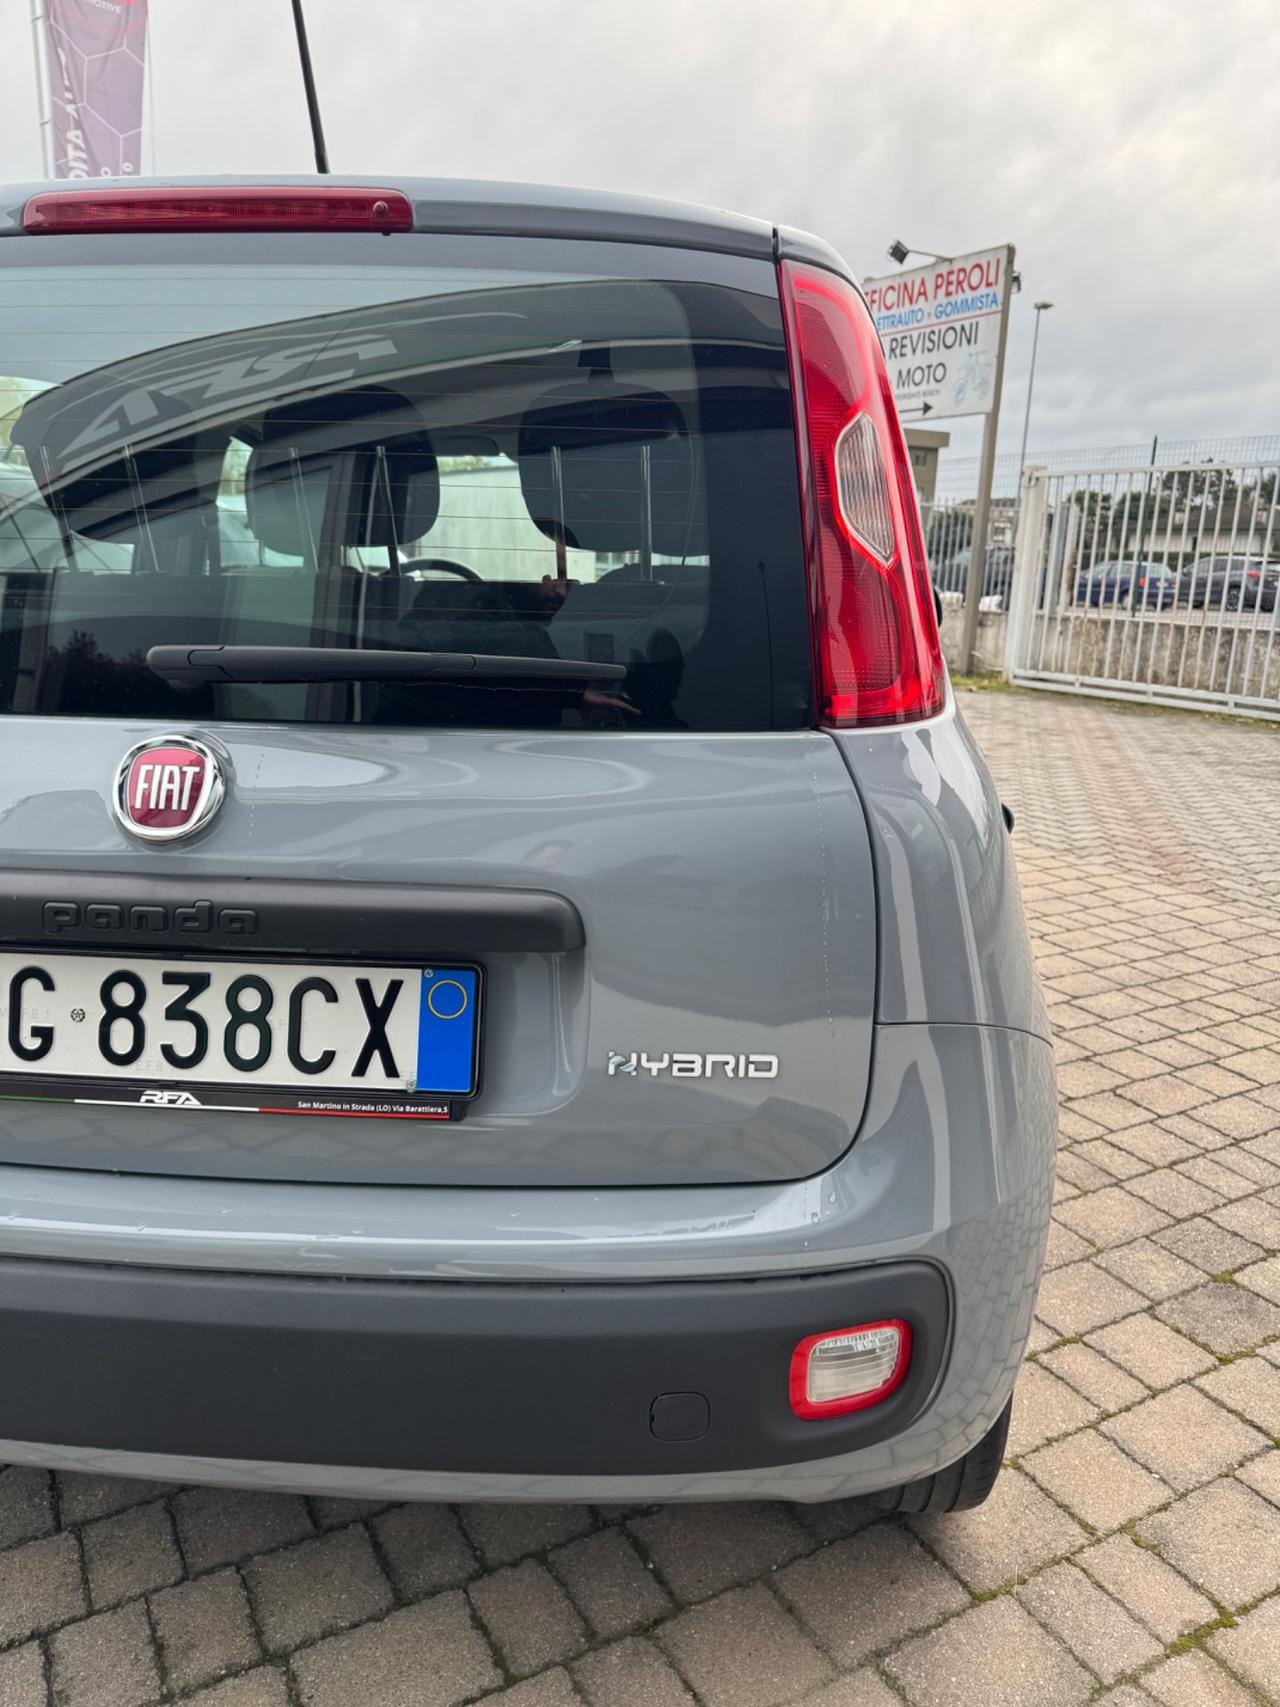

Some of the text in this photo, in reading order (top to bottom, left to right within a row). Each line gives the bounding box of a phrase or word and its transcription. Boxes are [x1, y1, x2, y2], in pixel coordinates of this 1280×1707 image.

[865, 258, 1000, 313] FICINA PEROLI
[934, 292, 999, 319] GOMMISTA
[889, 321, 979, 360] REVISIONI
[896, 362, 947, 389] MOTO
[135, 764, 200, 811] FIAT
[43, 900, 259, 935] panda
[140, 1090, 202, 1106] RFA
[297, 1101, 311, 1109] San
[313, 1101, 342, 1110] Martino
[343, 1102, 350, 1110] in
[351, 1103, 375, 1111] Strada
[376, 1104, 391, 1112] (LO)
[392, 1104, 404, 1112] Via
